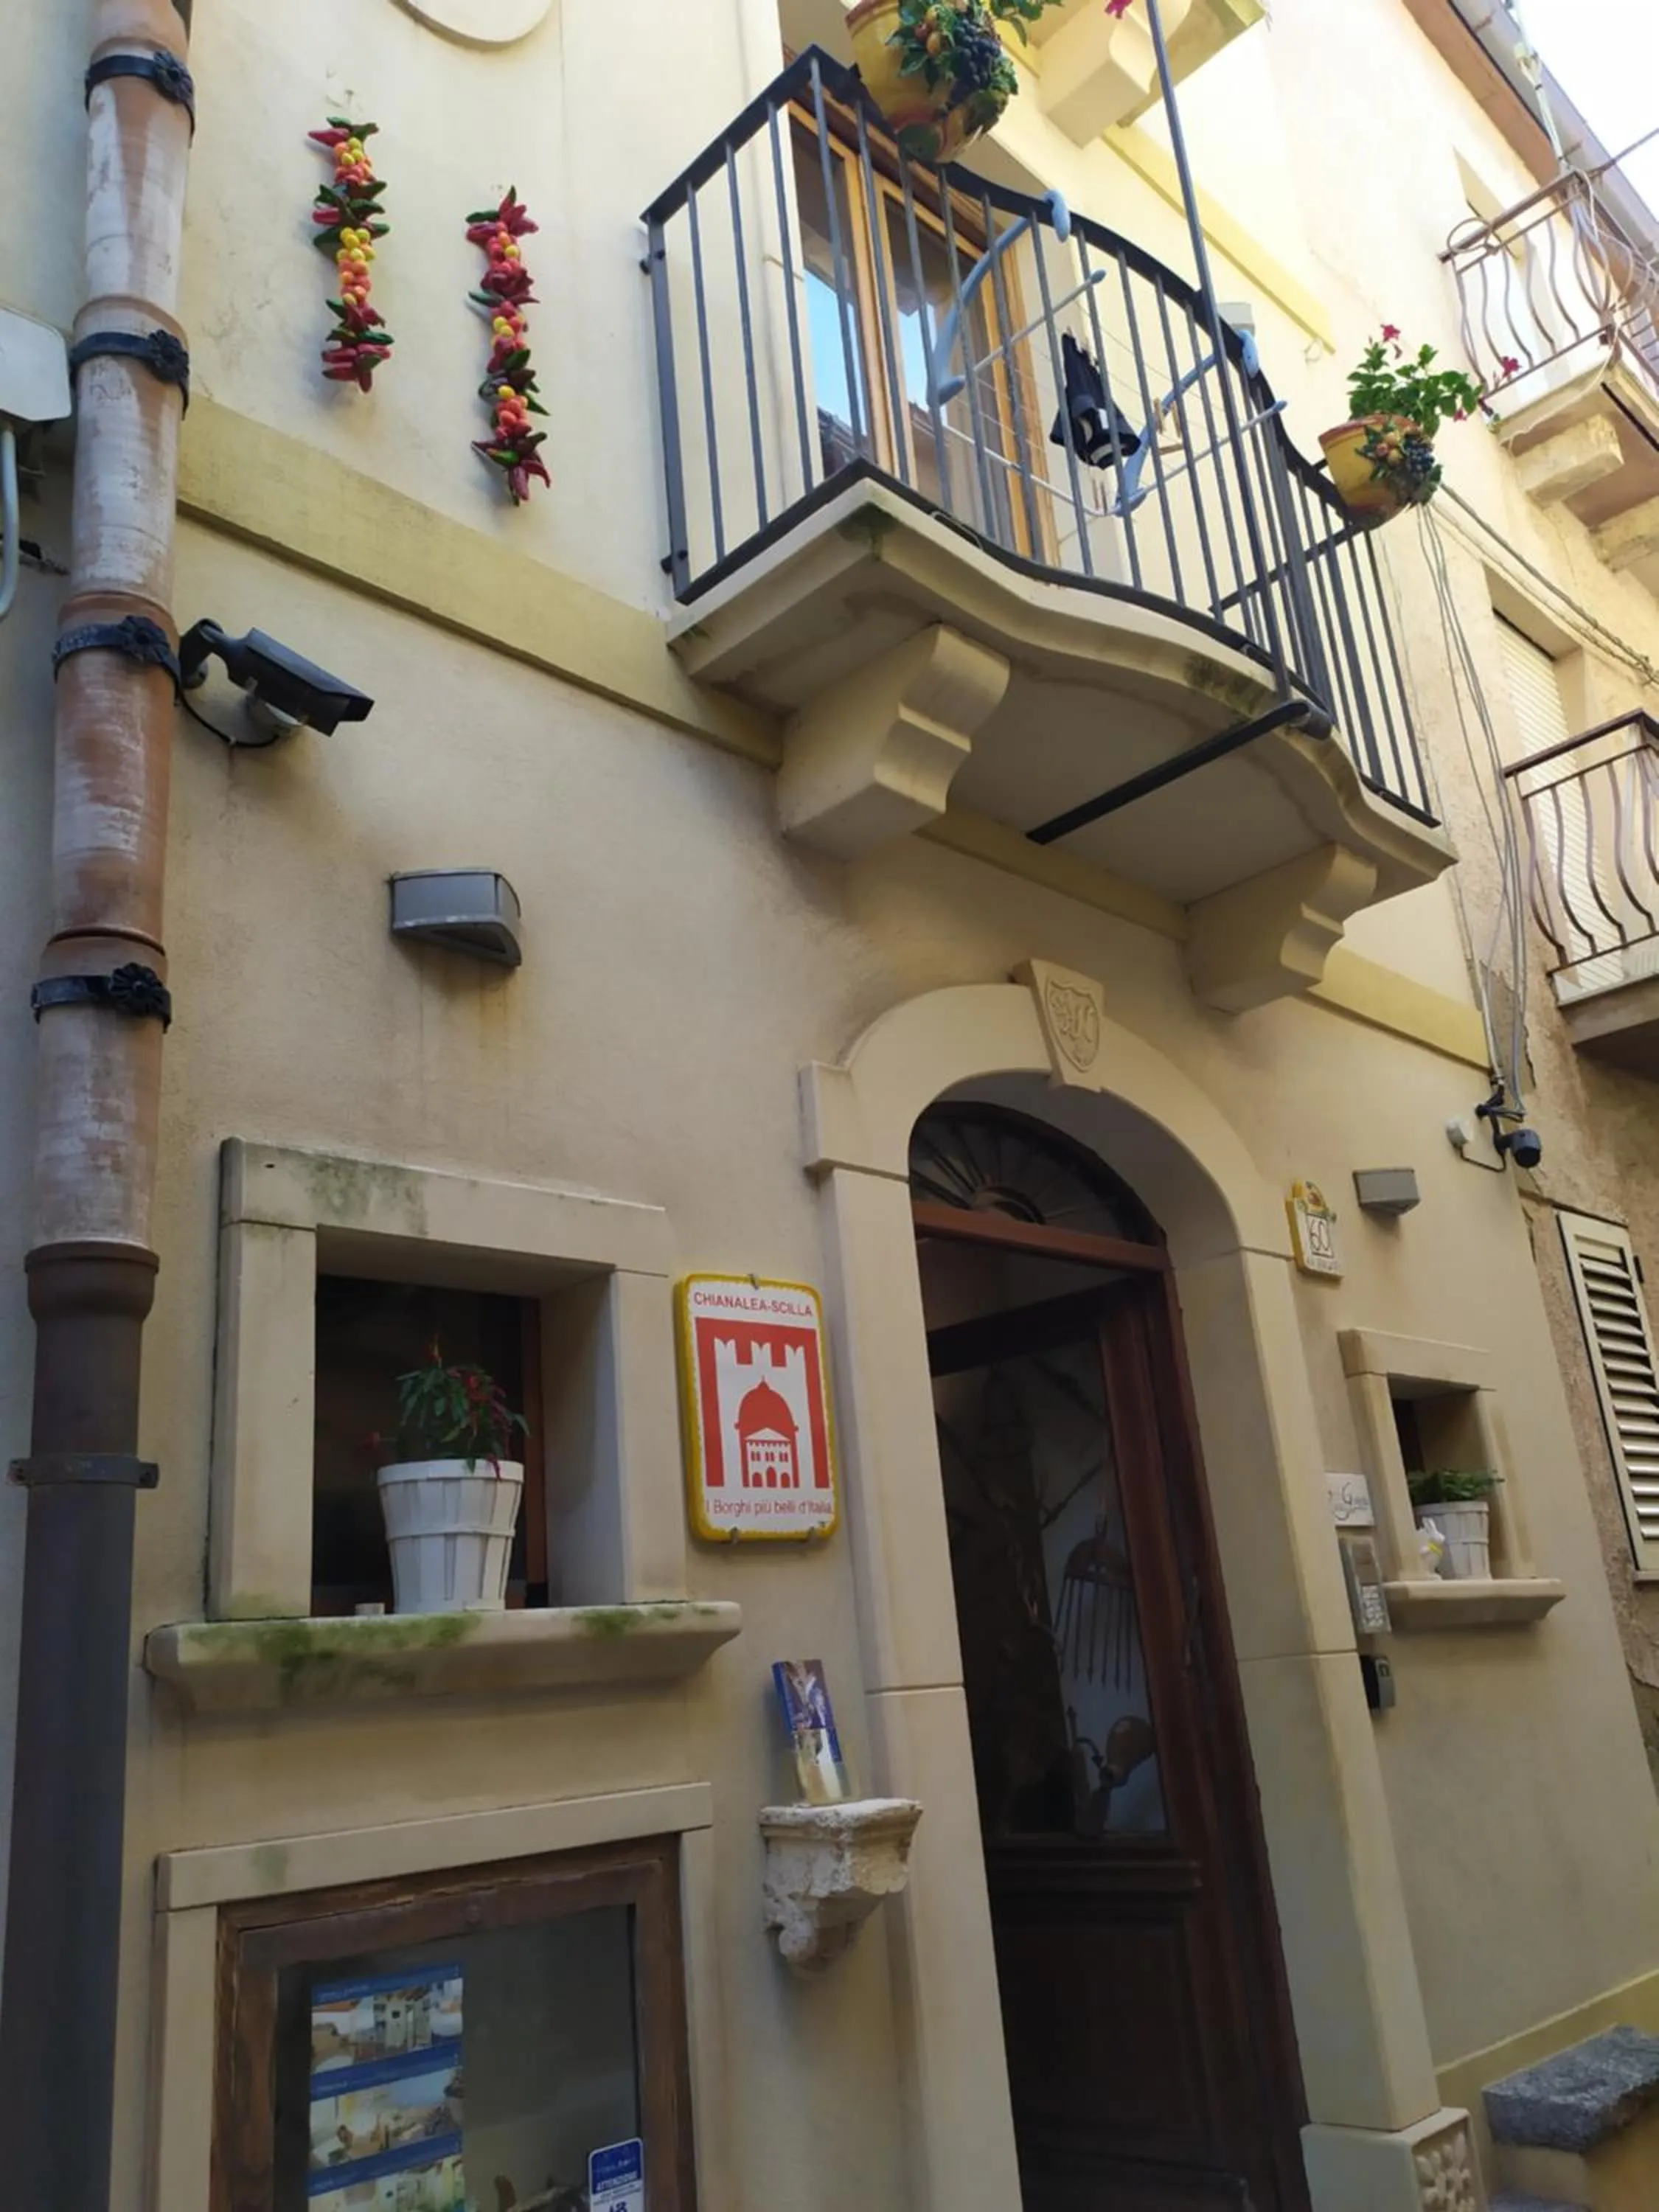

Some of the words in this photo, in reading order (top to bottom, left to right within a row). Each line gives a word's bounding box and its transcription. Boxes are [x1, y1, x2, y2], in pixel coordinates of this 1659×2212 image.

[694, 1291, 813, 1316] CHIANALEA-SCILLA
[714, 1498, 751, 1517] Borghi
[754, 1499, 771, 1516] più
[774, 1499, 796, 1513] belli
[799, 1499, 832, 1513] d'Italia
